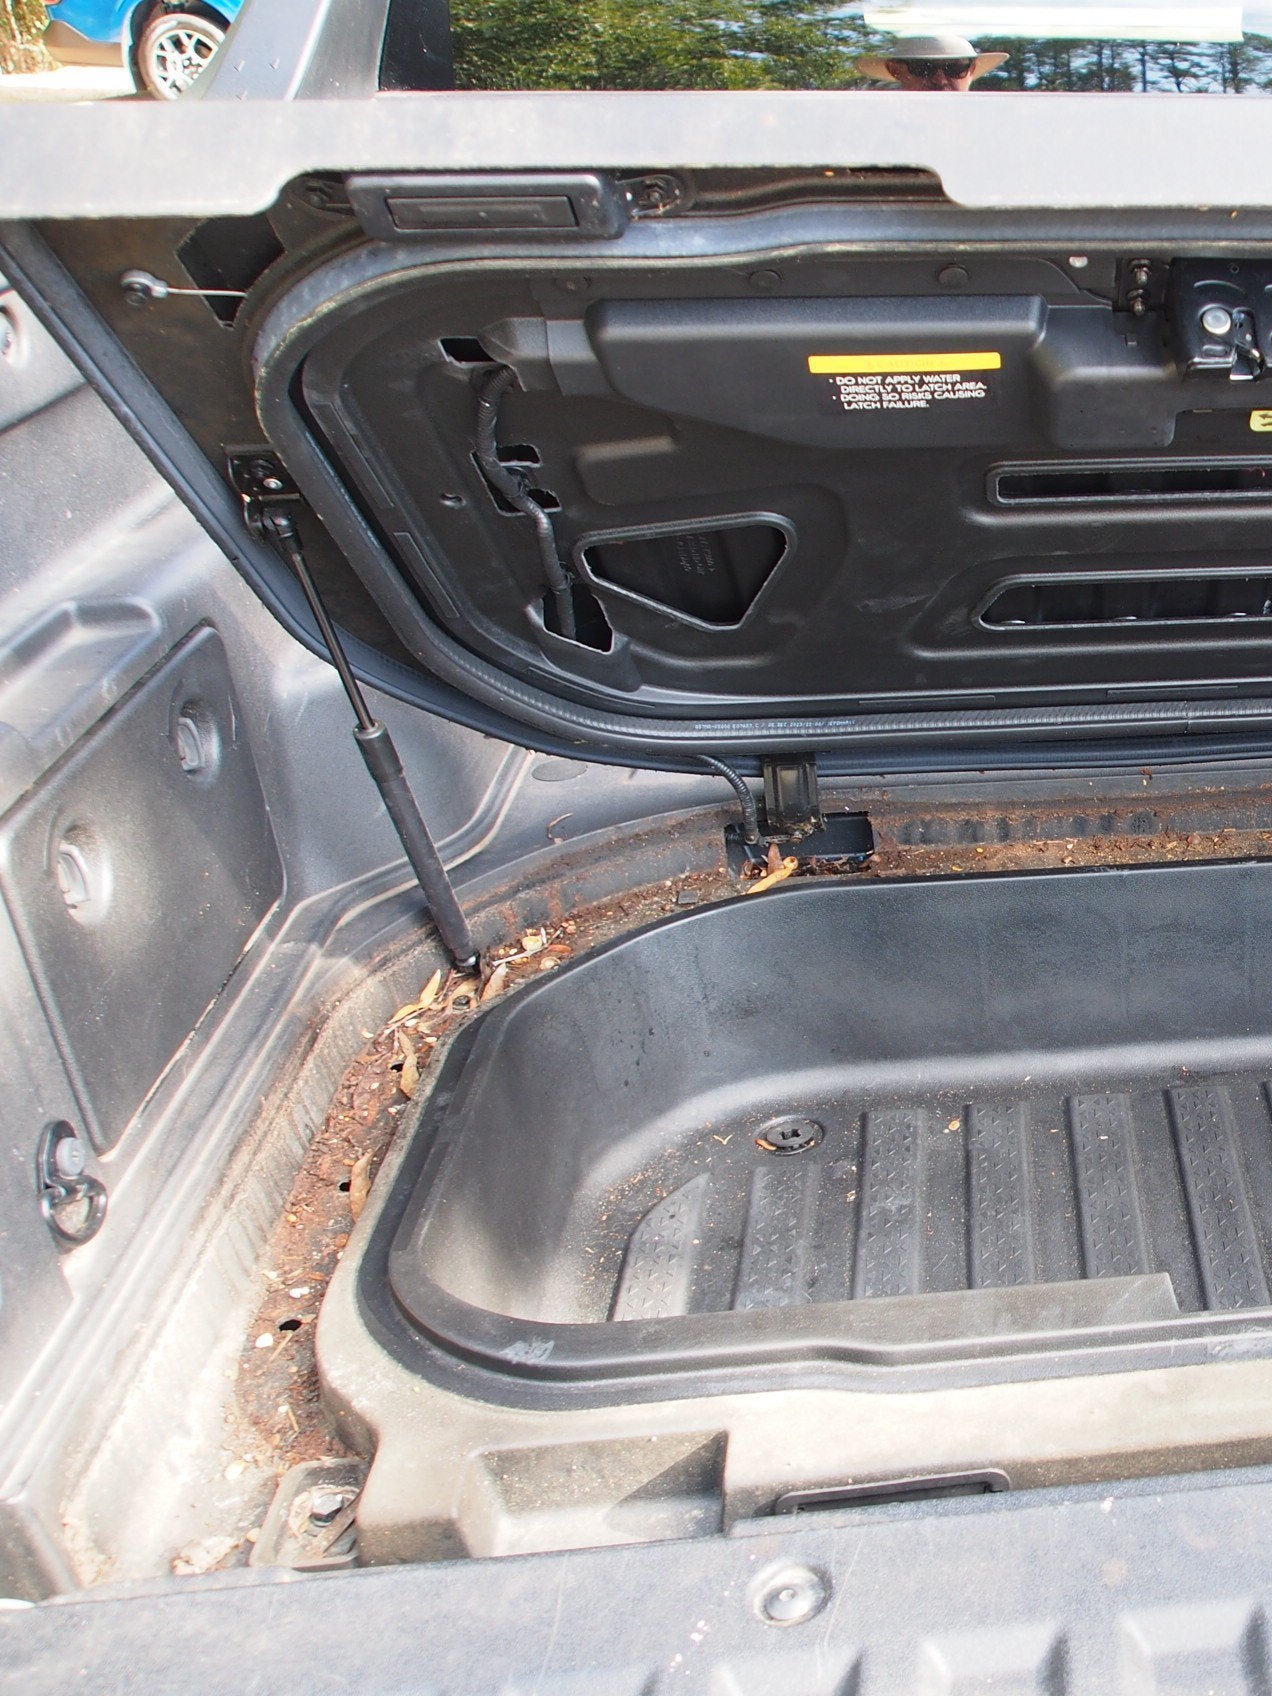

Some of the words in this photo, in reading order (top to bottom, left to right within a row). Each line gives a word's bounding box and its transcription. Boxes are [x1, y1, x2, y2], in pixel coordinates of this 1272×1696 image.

[836, 376, 856, 386] DO
[857, 375, 882, 385] NOT
[885, 374, 920, 384] APPLY
[922, 373, 961, 383] WATER
[840, 384, 893, 394] DIRECTLY
[895, 384, 913, 393] TO
[914, 382, 952, 392] LATCH
[953, 381, 988, 391] AREA.
[840, 393, 880, 402] DOING
[881, 392, 900, 401] SO
[901, 391, 933, 400] RISKS
[933, 389, 986, 399] CAUSING
[843, 402, 881, 410] LATCH
[882, 400, 930, 410] FAILURE.
